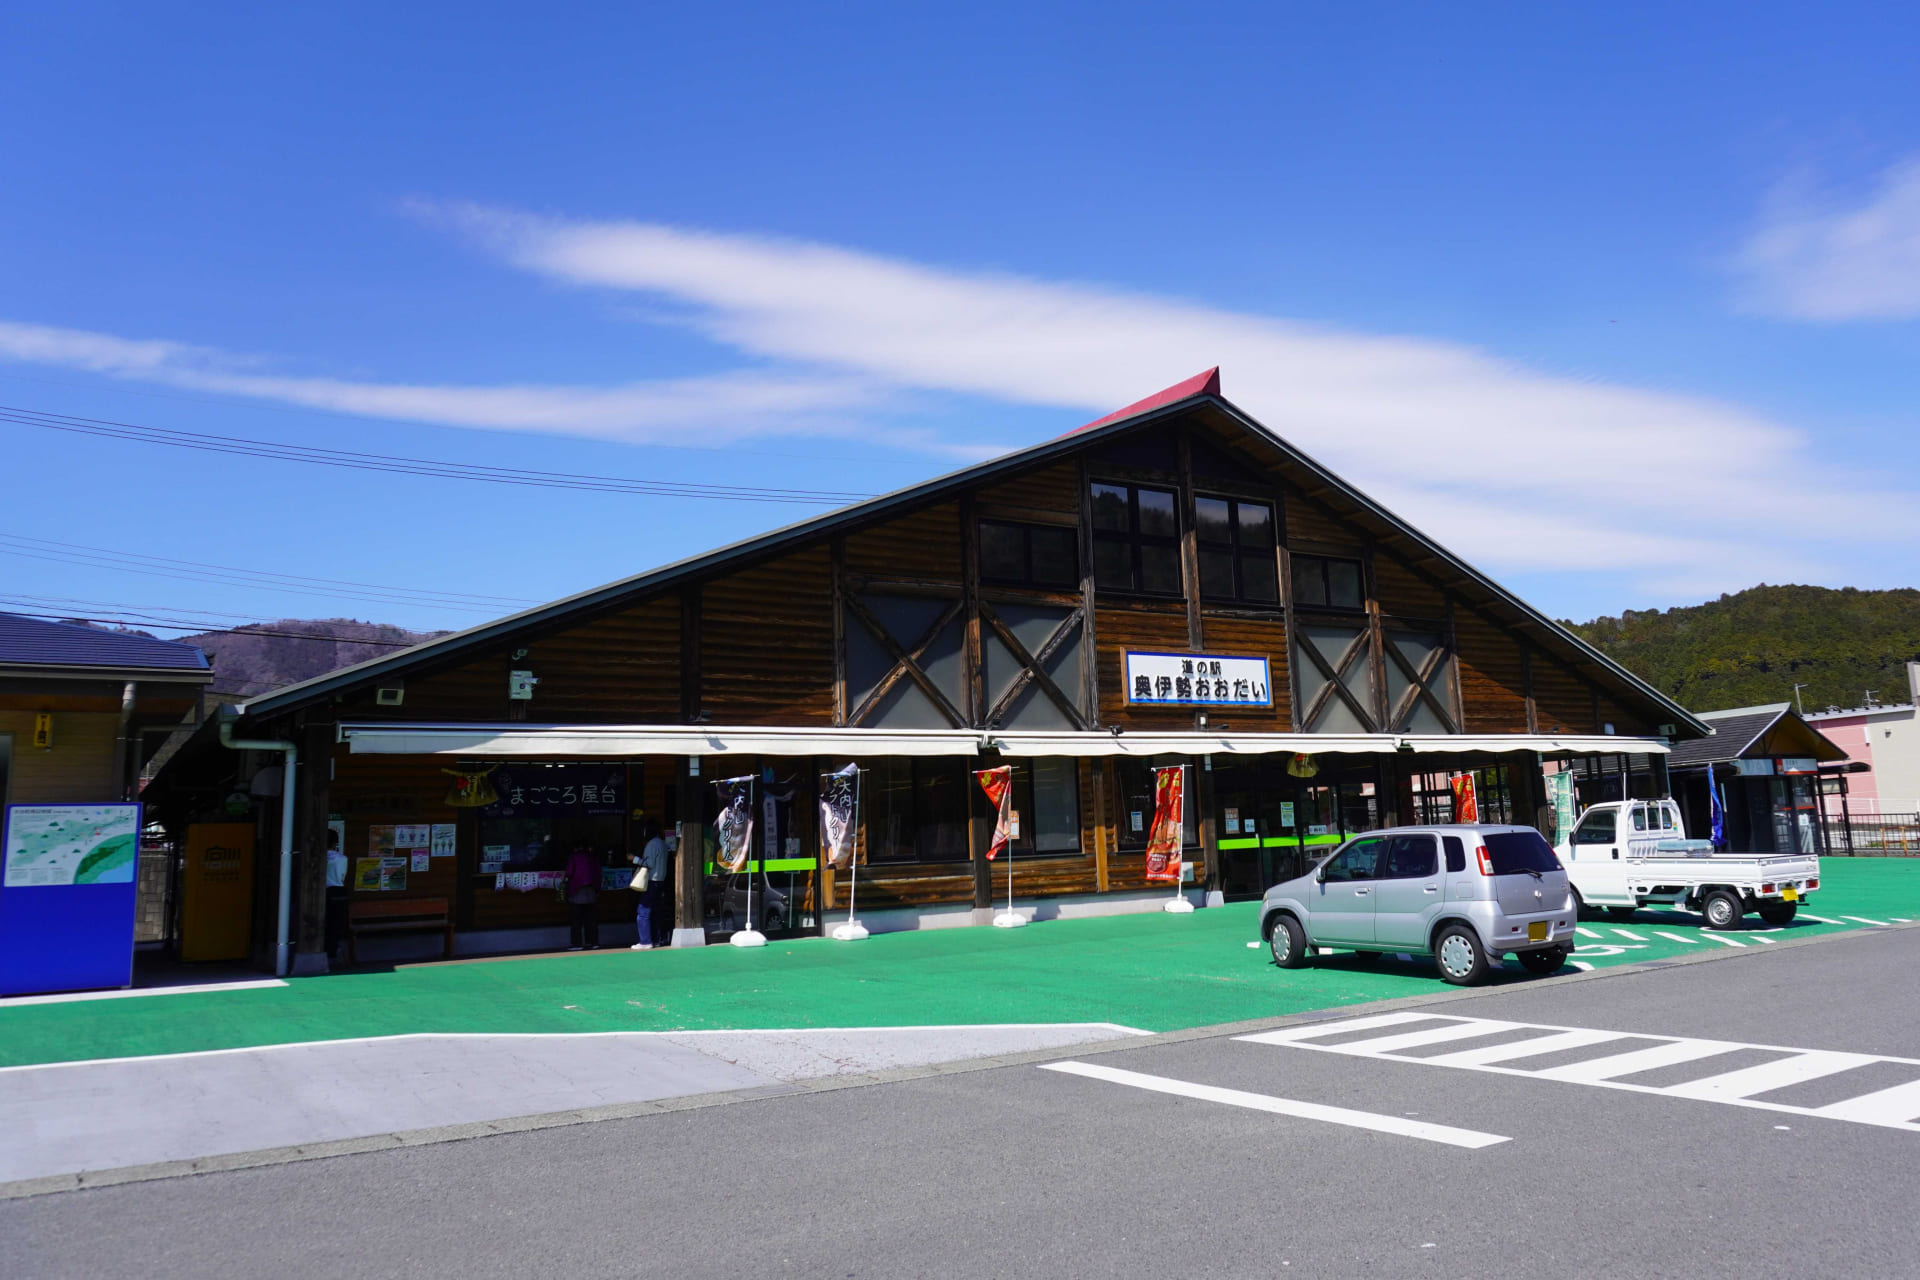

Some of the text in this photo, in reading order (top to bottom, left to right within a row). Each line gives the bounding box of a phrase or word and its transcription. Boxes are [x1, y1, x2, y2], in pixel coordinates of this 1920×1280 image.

[1182, 659, 1222, 675] 道の駅
[1135, 675, 1266, 699] 奥伊勢おおだい
[510, 785, 616, 805] まごころ屋台
[734, 786, 746, 825] 内山
